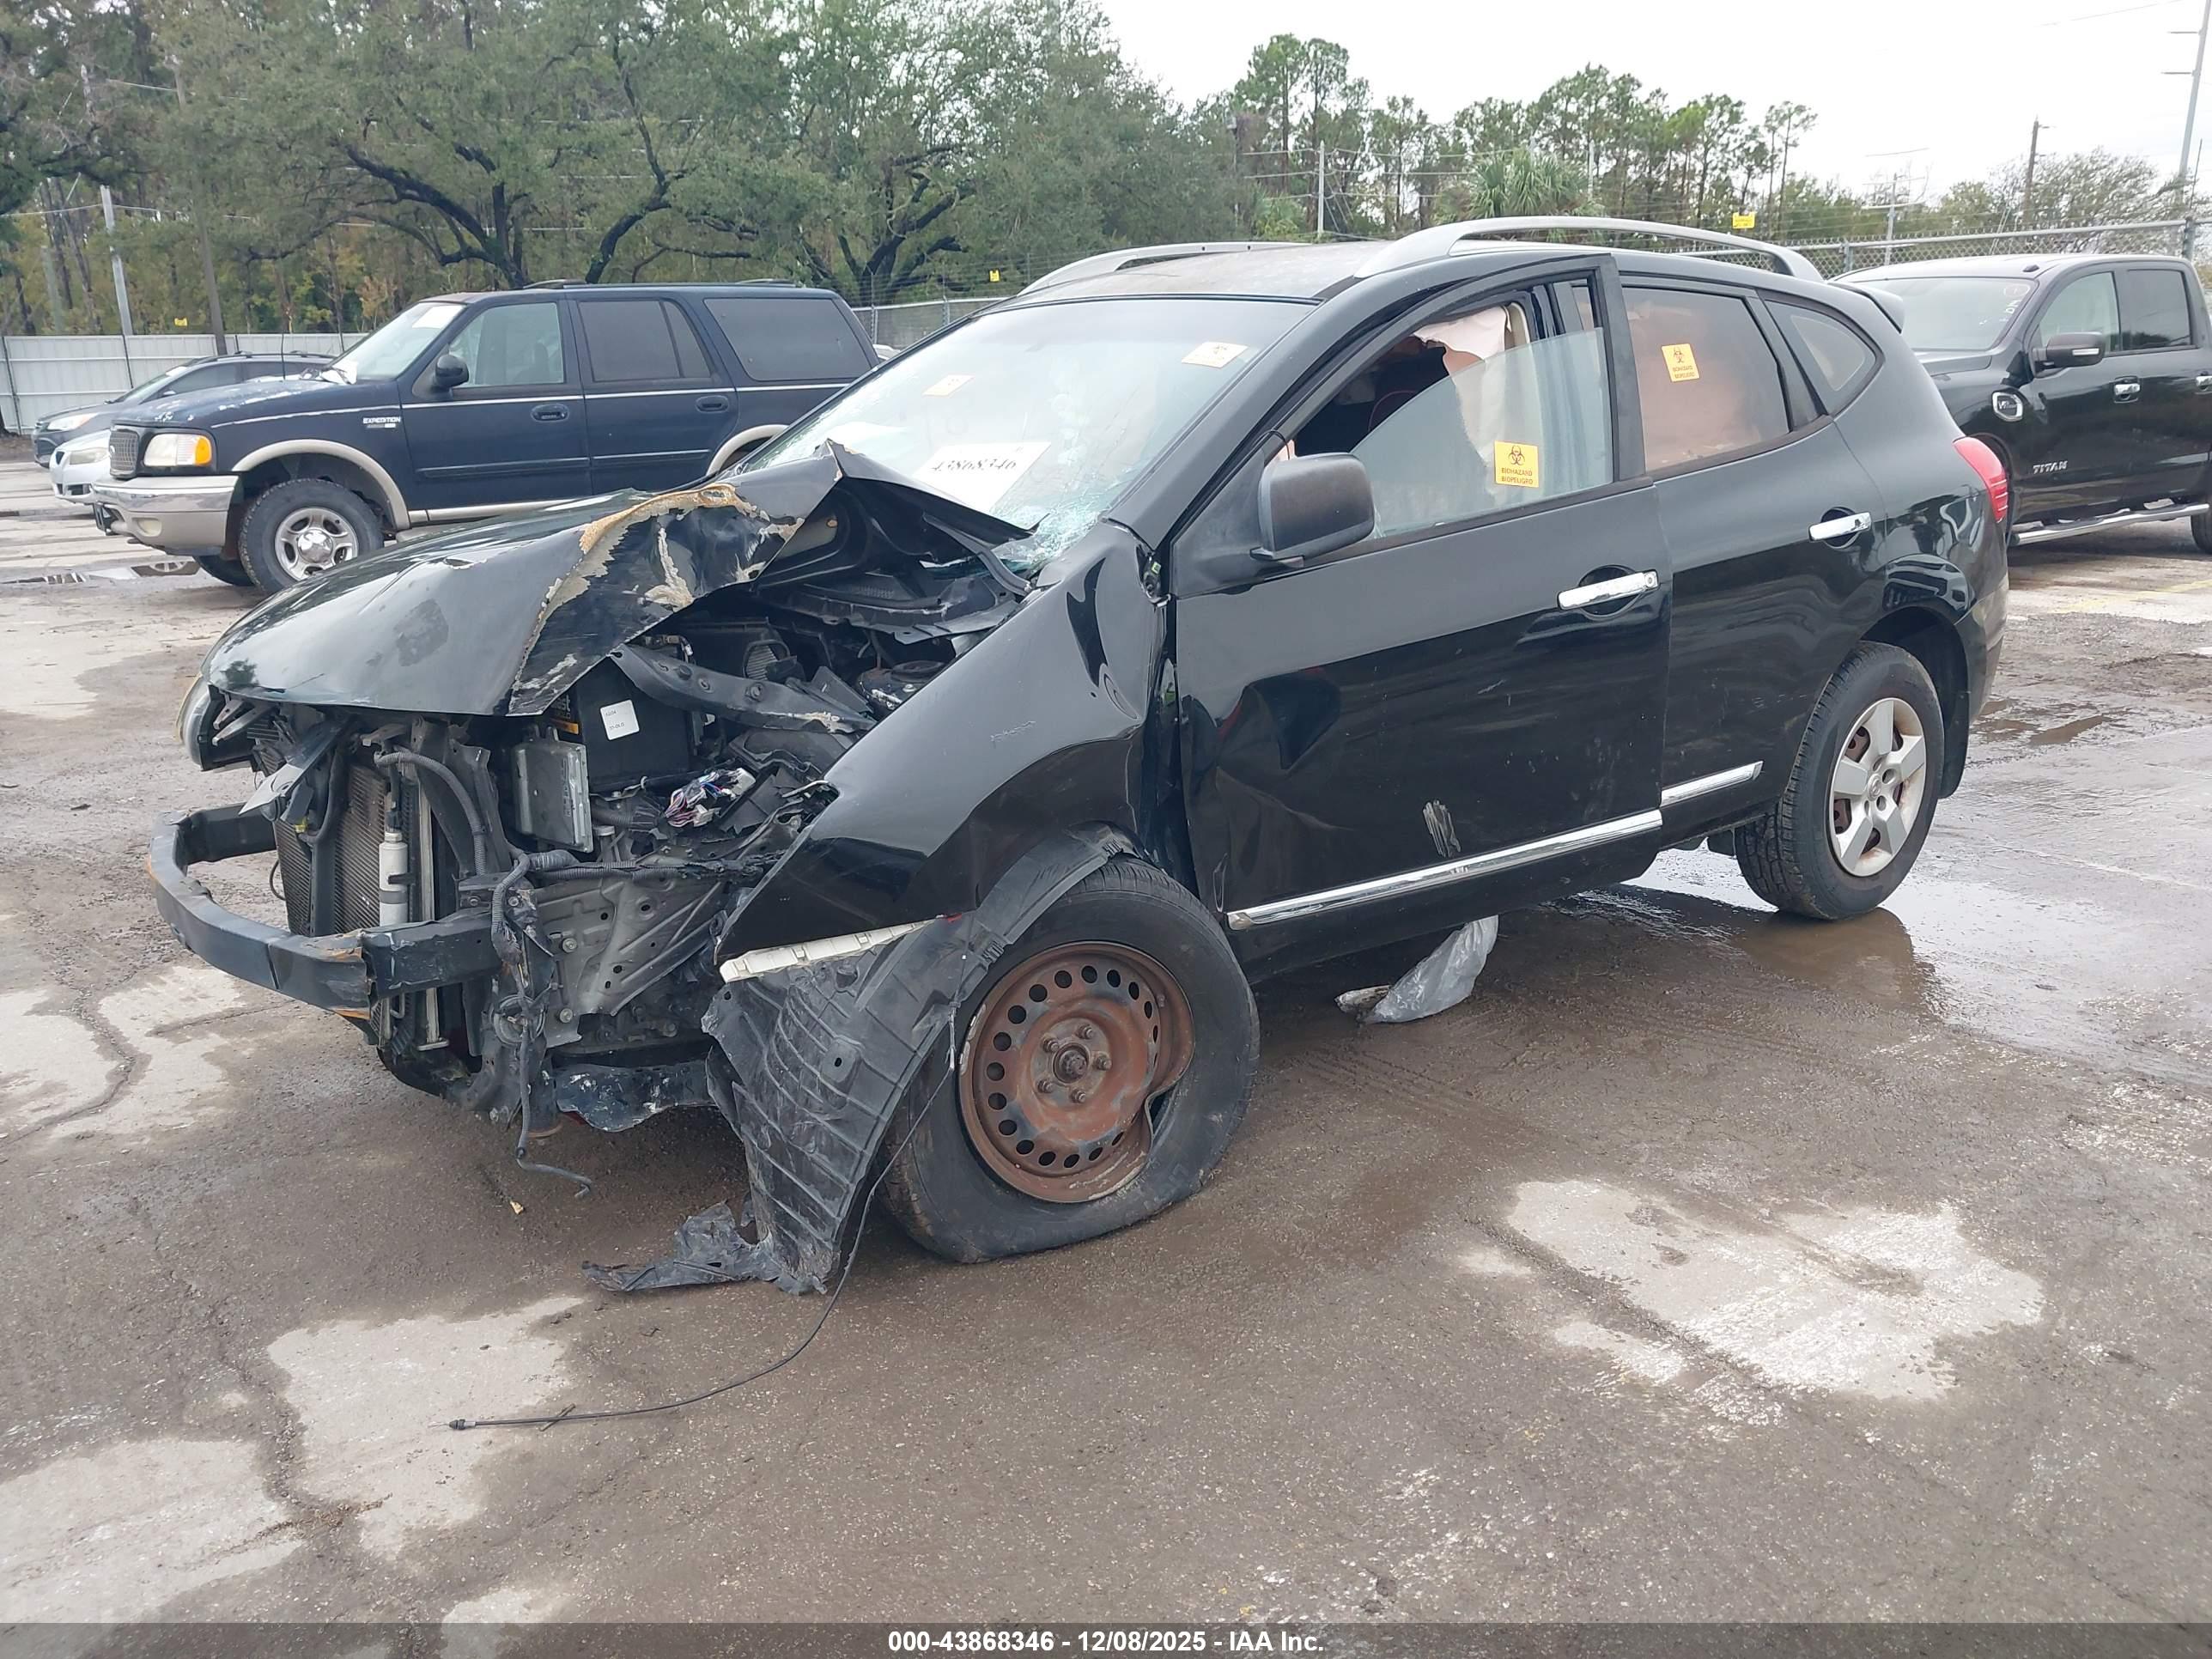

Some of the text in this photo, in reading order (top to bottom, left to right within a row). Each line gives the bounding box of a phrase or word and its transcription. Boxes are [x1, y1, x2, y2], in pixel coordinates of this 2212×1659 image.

[1501, 467, 1533, 477] BIOHAZARD
[2033, 460, 2069, 474] TITAN
[1501, 476, 1534, 485] BIOPELIGRO
